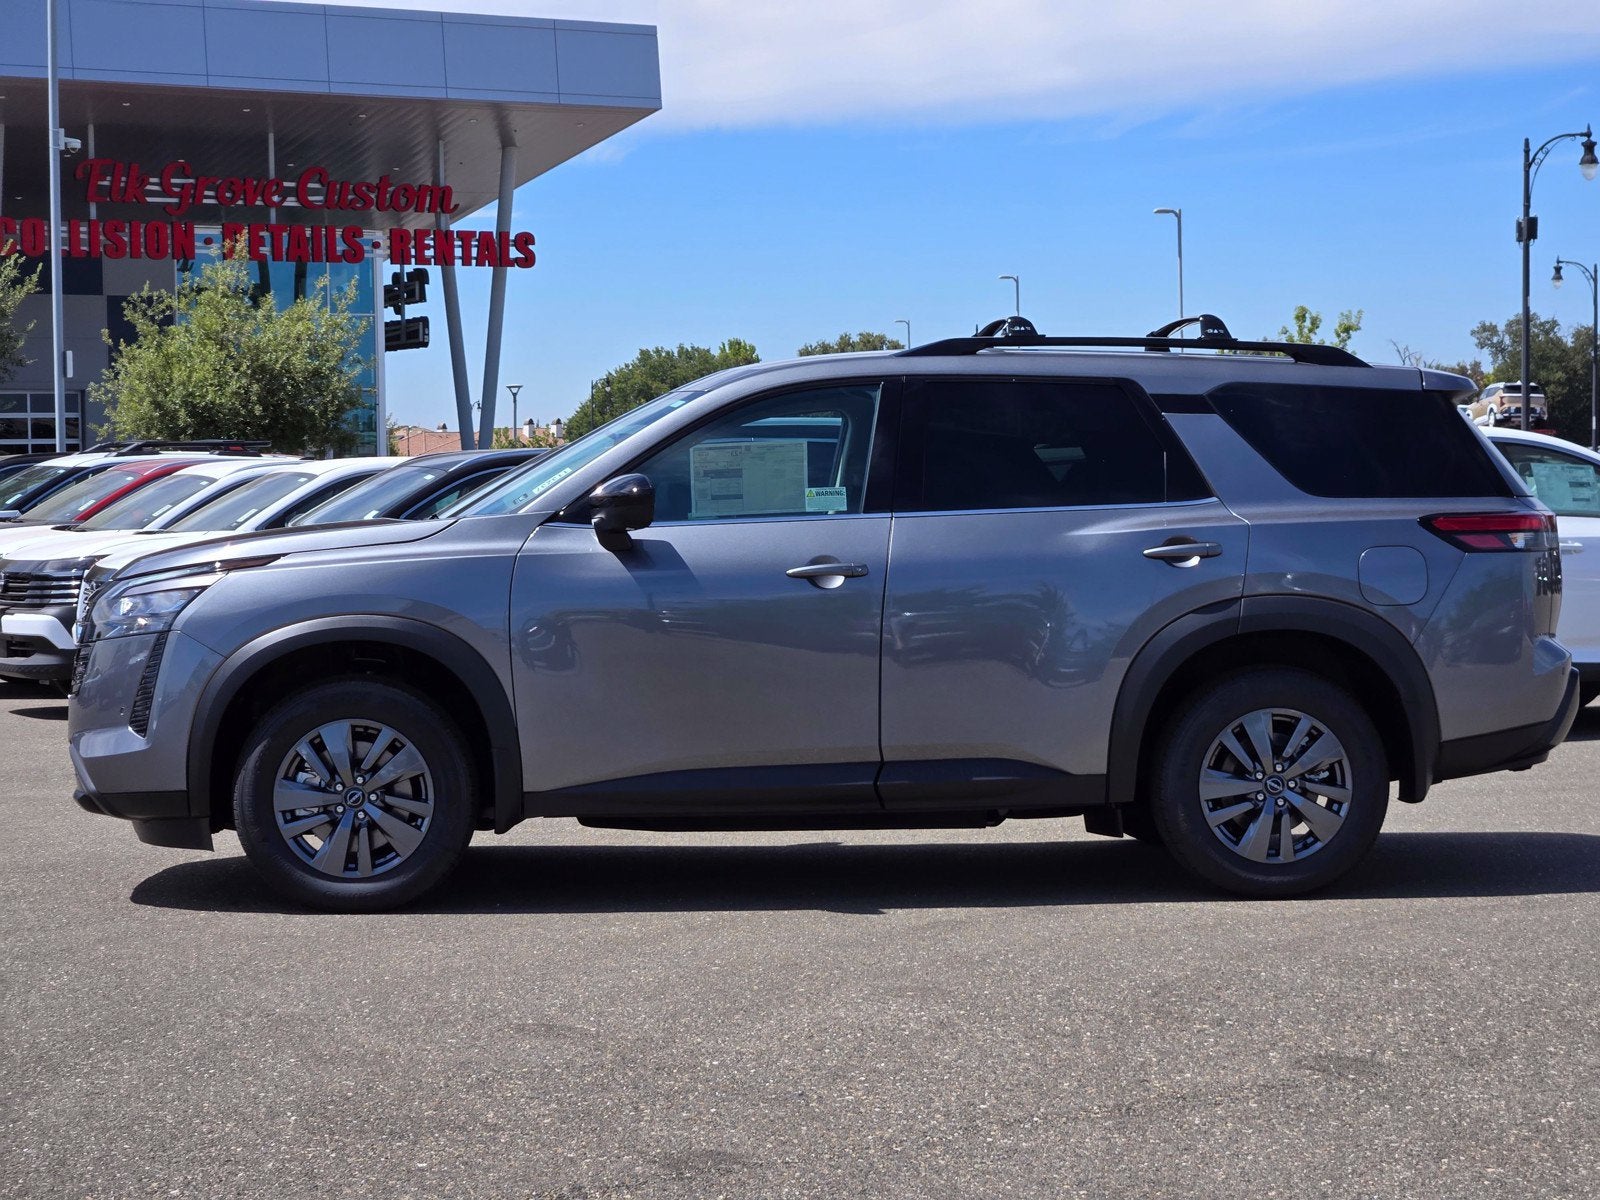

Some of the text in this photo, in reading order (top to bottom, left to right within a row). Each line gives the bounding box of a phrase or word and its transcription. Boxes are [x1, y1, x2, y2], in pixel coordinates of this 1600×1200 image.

[75, 158, 460, 216] Elk Grove Custom
[0, 216, 195, 261] COLISION
[390, 228, 536, 269] RENTALS
